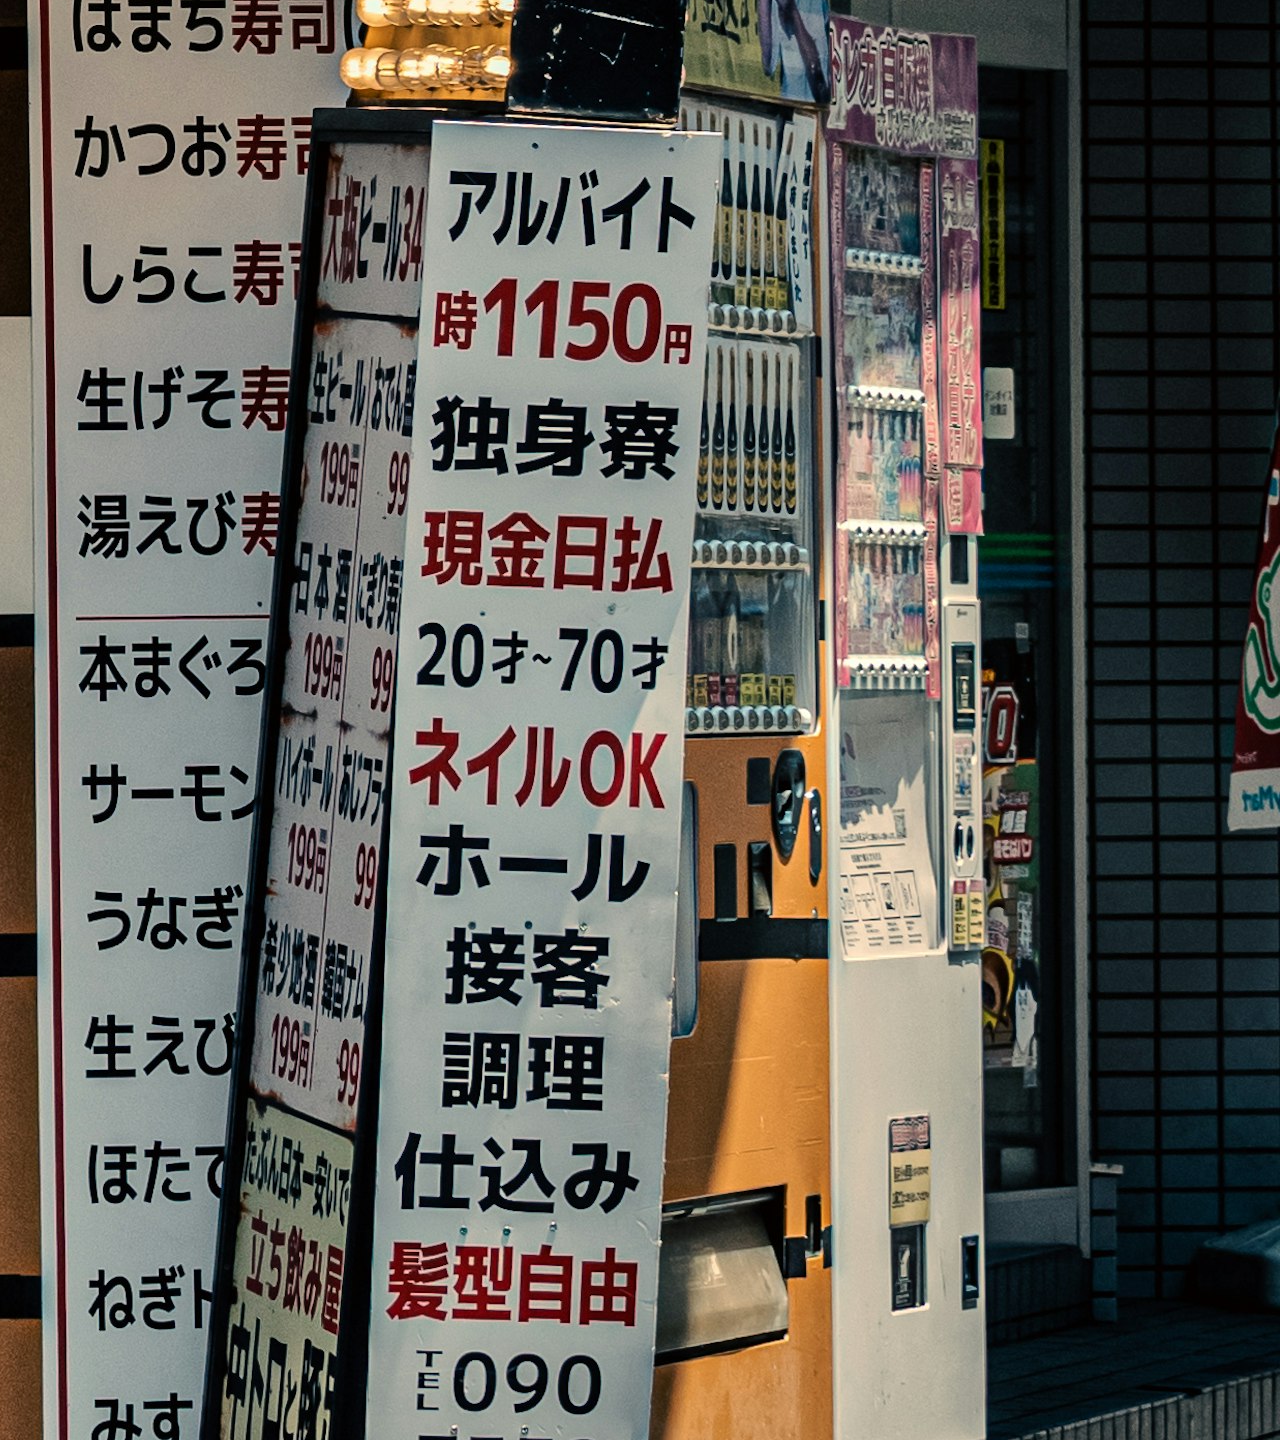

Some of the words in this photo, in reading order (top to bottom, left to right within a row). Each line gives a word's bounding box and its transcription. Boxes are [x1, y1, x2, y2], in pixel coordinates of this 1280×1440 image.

[447, 166, 698, 254] アルバイト
[311, 351, 366, 428] 生ビール
[431, 394, 683, 482] 独身寮
[295, 541, 353, 624] 日本酒
[420, 508, 675, 595] 現金日払
[78, 633, 266, 703] 本まぐろ
[81, 764, 258, 825] サーモン
[279, 735, 334, 814] ハイボール
[407, 715, 668, 812] ネイルOK
[415, 823, 652, 905] ホール
[85, 885, 245, 953] うなぎ
[263, 918, 320, 1011] 希少地酒
[443, 924, 614, 1011] 接客
[85, 1012, 236, 1080] 生えび
[439, 1030, 606, 1115] 調理
[393, 1131, 641, 1217] 仕込み
[246, 1208, 344, 1336] 立ち飲み屋
[384, 1239, 639, 1328] 髪型自由
[452, 1348, 604, 1418] 090
